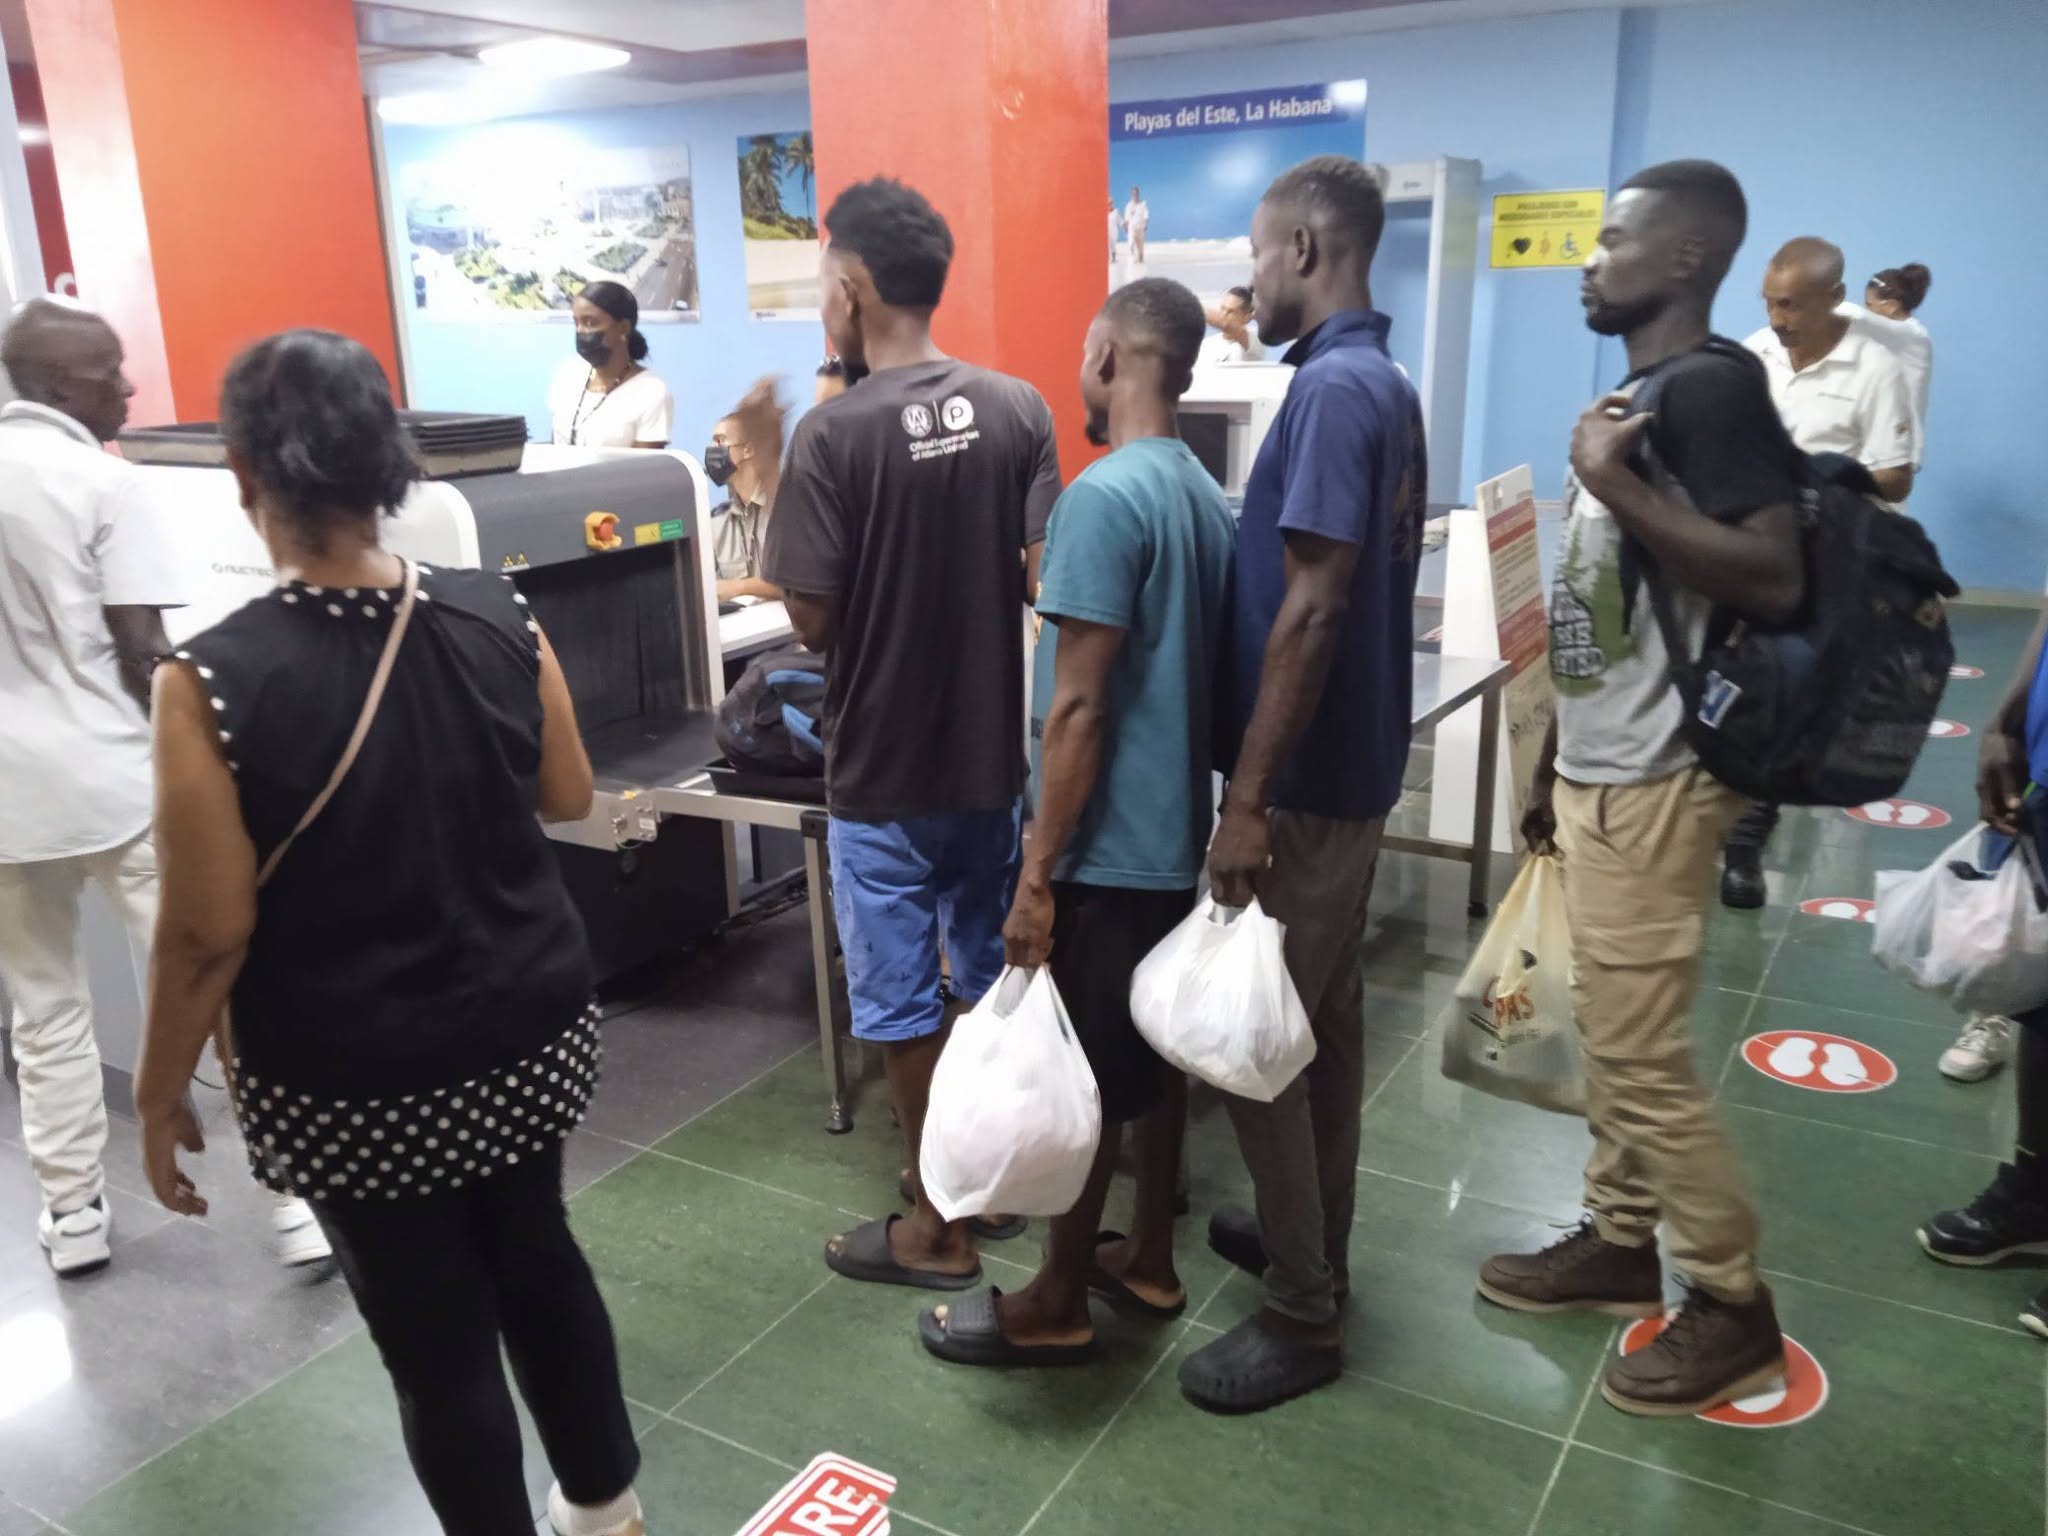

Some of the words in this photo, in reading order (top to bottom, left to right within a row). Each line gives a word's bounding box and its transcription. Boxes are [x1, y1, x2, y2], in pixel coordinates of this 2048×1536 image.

[1125, 111, 1172, 134] Playas
[1176, 106, 1200, 127] del
[1204, 104, 1240, 126] Este,
[1245, 101, 1264, 121] La
[1269, 97, 1333, 119] Habana
[772, 1477, 877, 1536] RE
